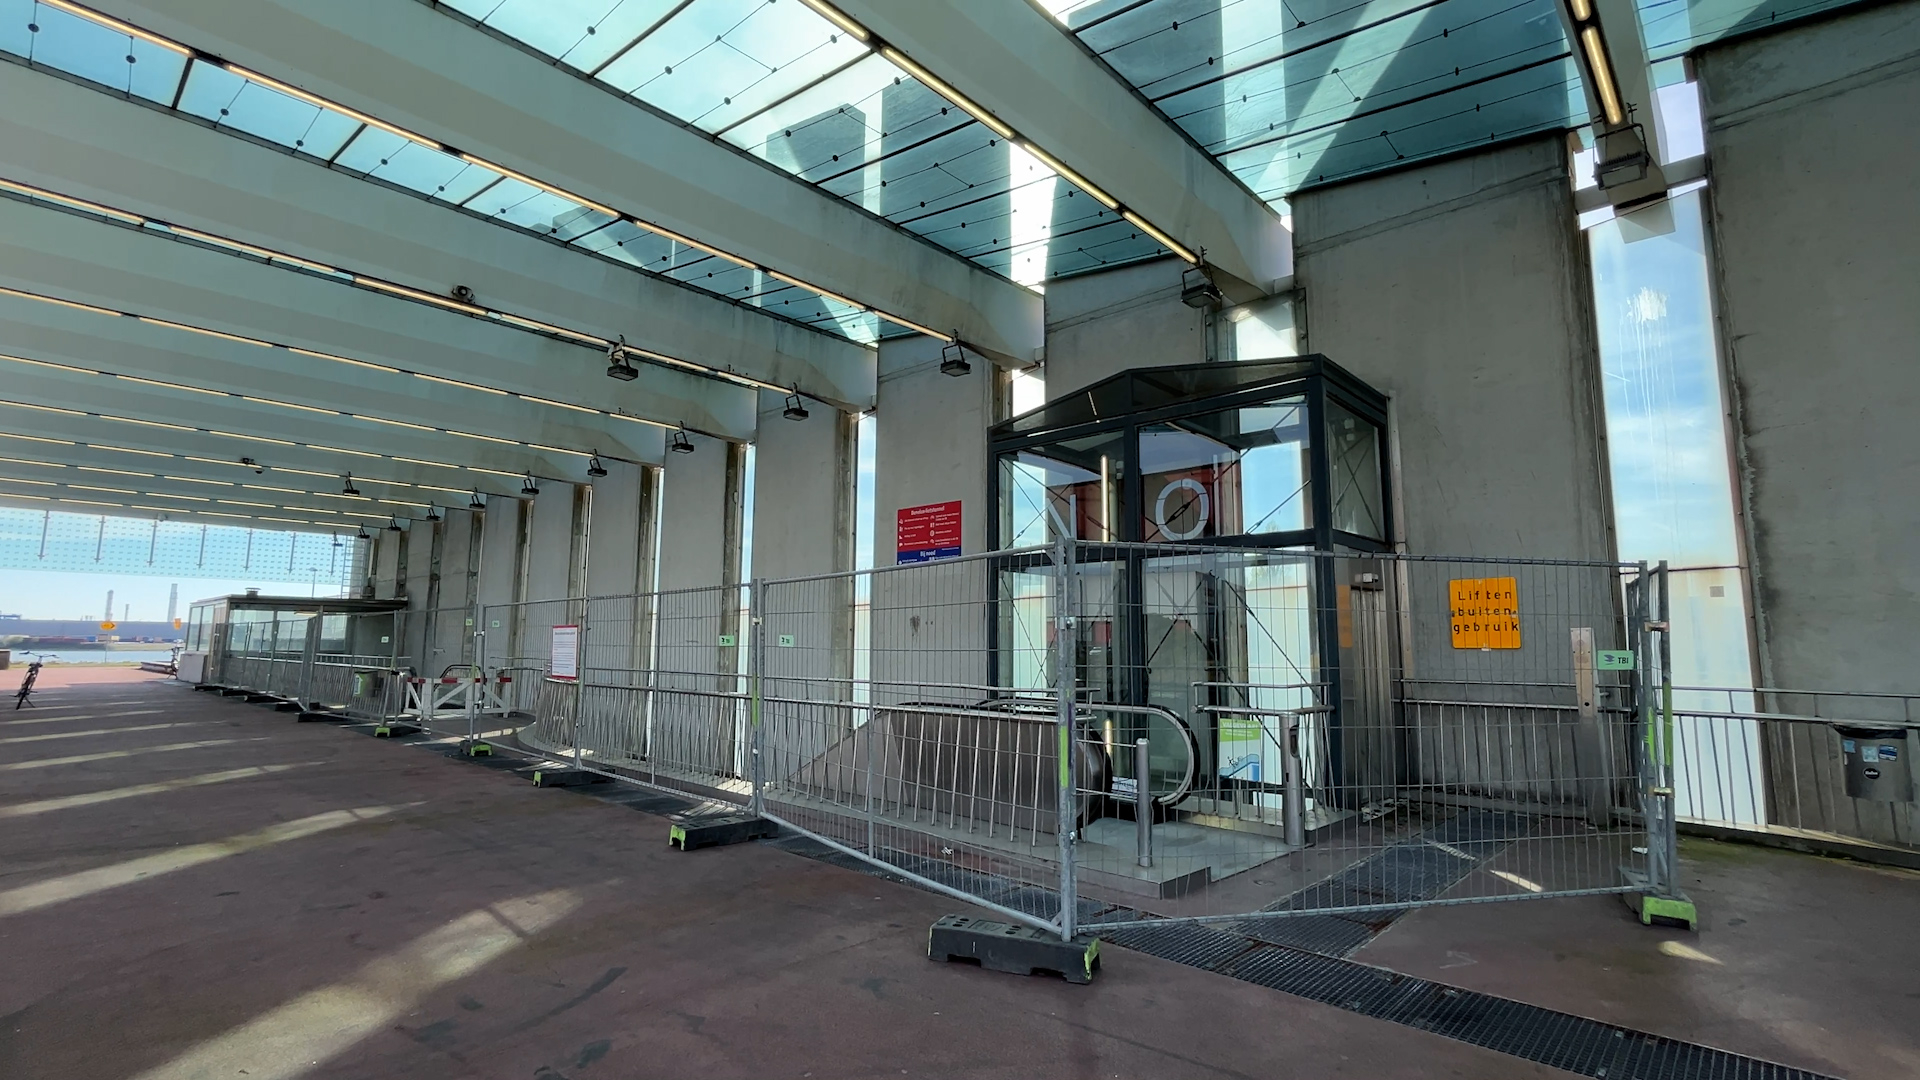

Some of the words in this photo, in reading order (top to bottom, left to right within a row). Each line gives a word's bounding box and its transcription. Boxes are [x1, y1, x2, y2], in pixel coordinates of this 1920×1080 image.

[1458, 590, 1511, 600] Liften
[1457, 606, 1511, 616] buiten
[1453, 621, 1519, 634] gebruik
[1618, 656, 1629, 665] TBI
